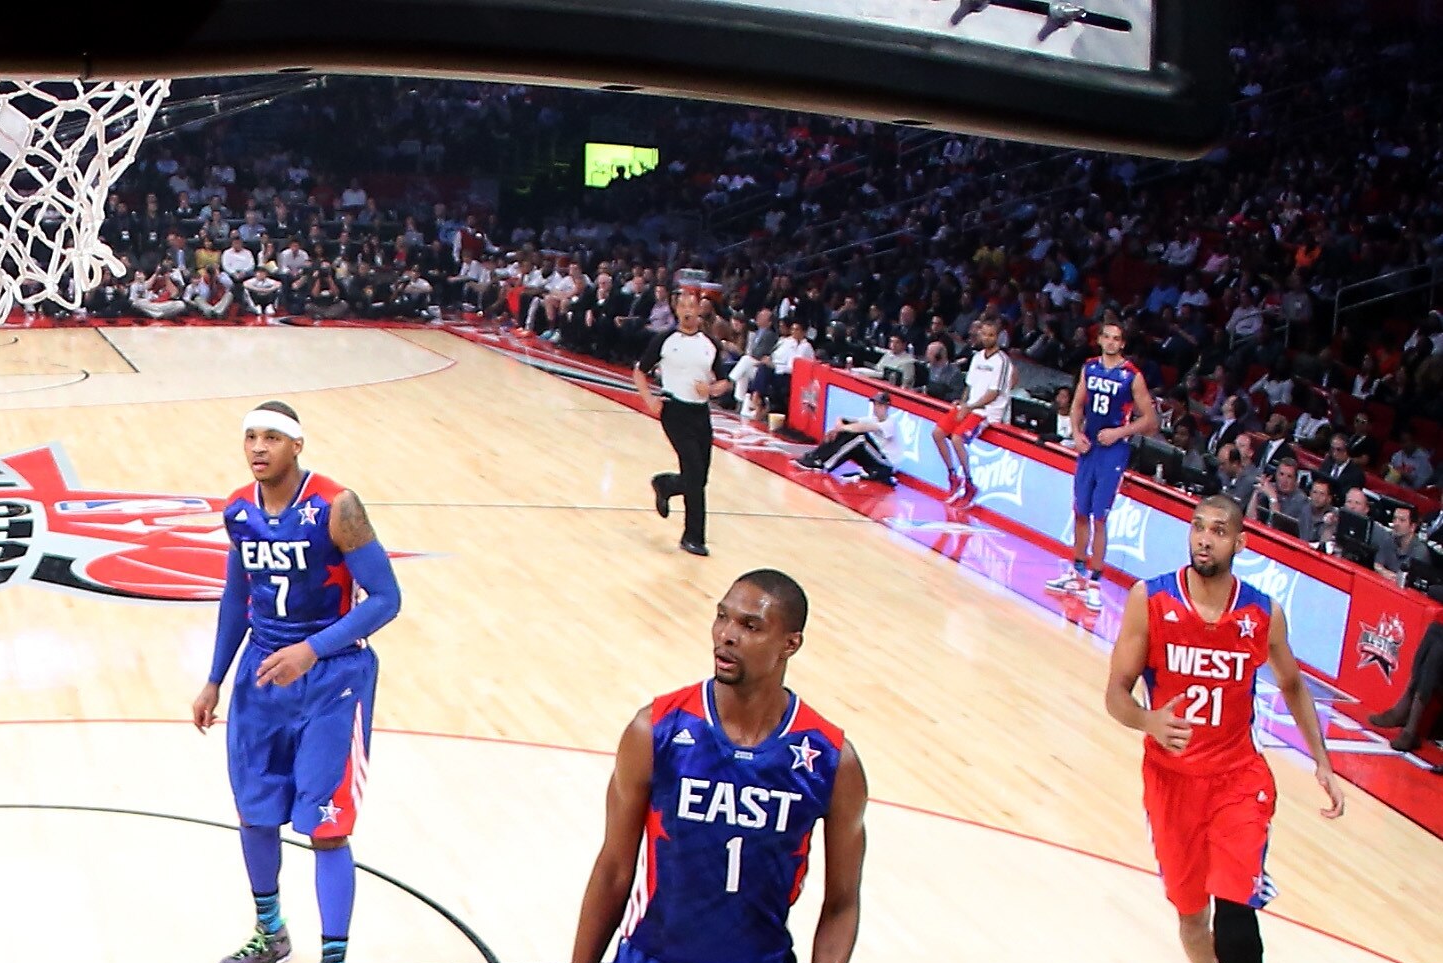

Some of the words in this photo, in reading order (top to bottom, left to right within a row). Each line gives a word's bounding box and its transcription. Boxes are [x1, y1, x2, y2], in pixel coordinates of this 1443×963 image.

[1087, 375, 1123, 396] EAST
[1093, 393, 1110, 415] 13
[241, 541, 310, 570] EAST
[270, 575, 290, 617] 7
[1166, 643, 1251, 681] WEST
[1185, 684, 1223, 727] 21
[677, 777, 803, 832] EAST
[725, 836, 744, 893] 1
